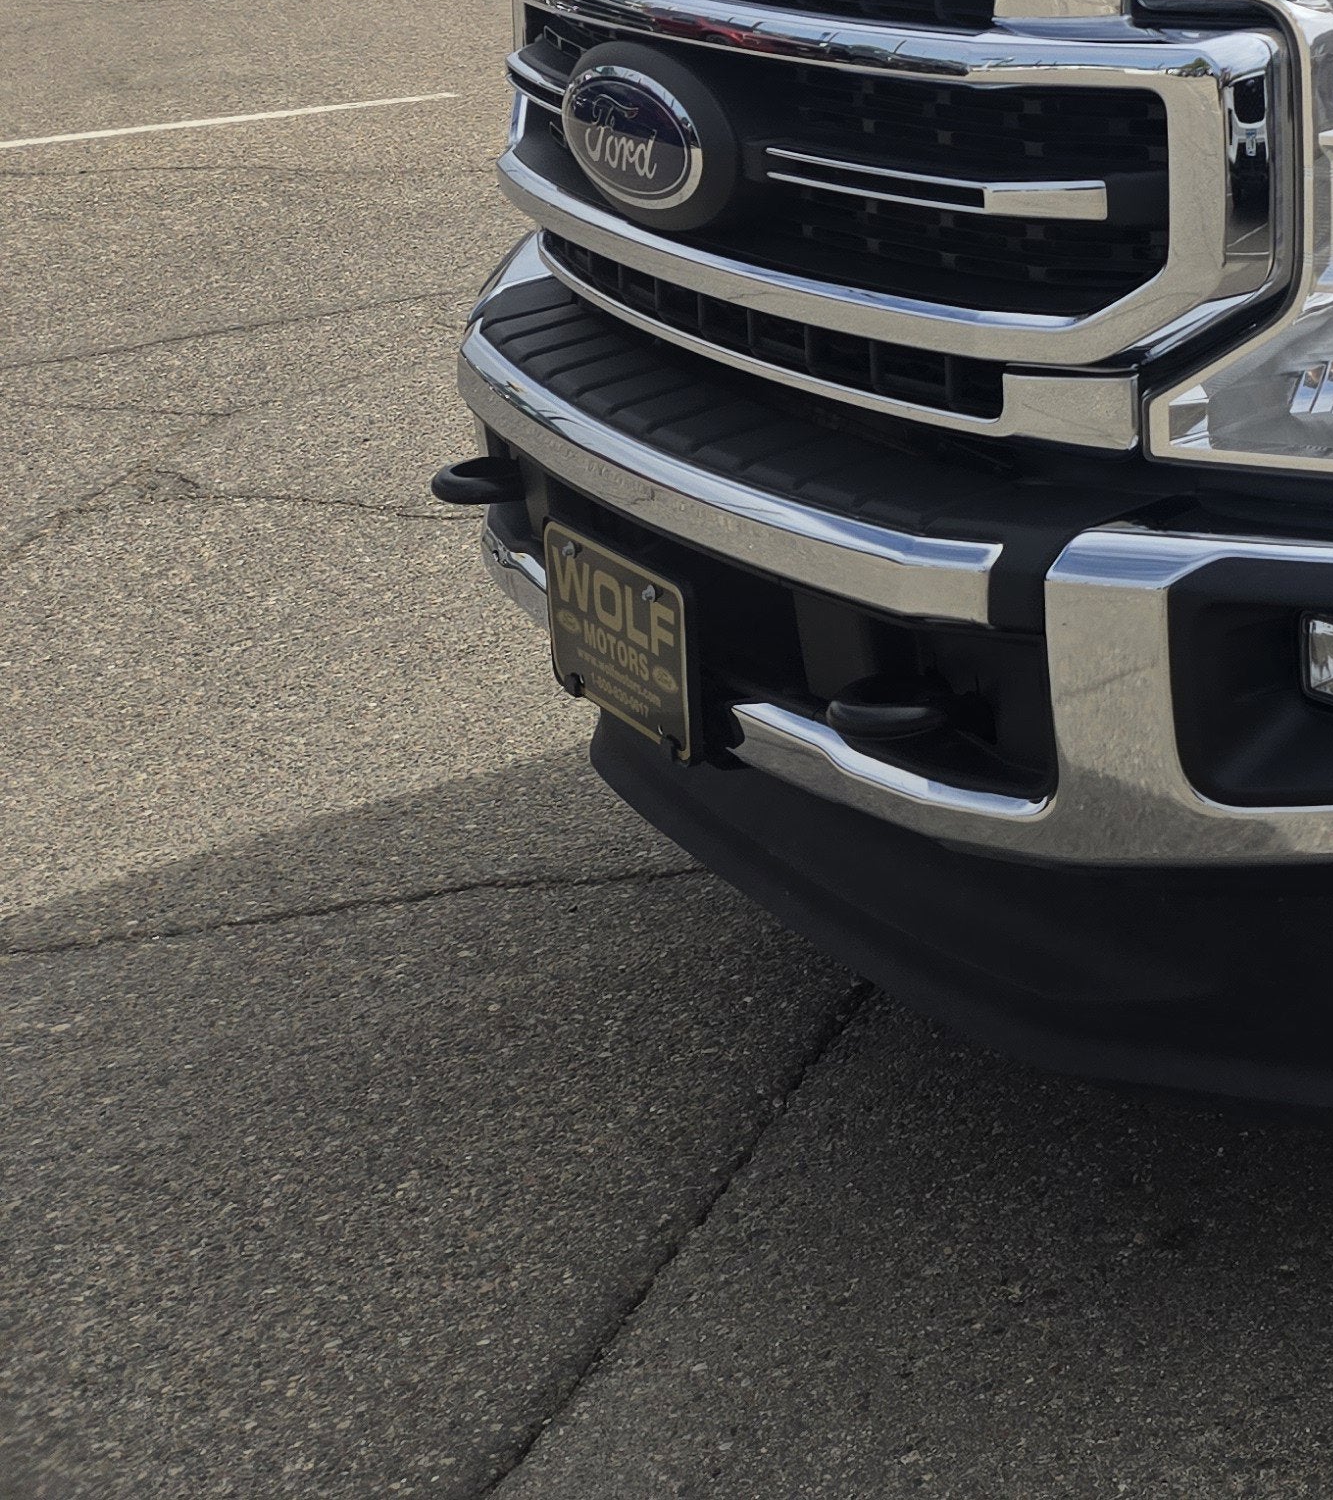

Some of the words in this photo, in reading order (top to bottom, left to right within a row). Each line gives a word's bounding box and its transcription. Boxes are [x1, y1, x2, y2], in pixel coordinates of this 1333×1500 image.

[585, 93, 658, 180] Ford
[552, 545, 675, 657] WOLF
[583, 619, 650, 682] MOTORS
